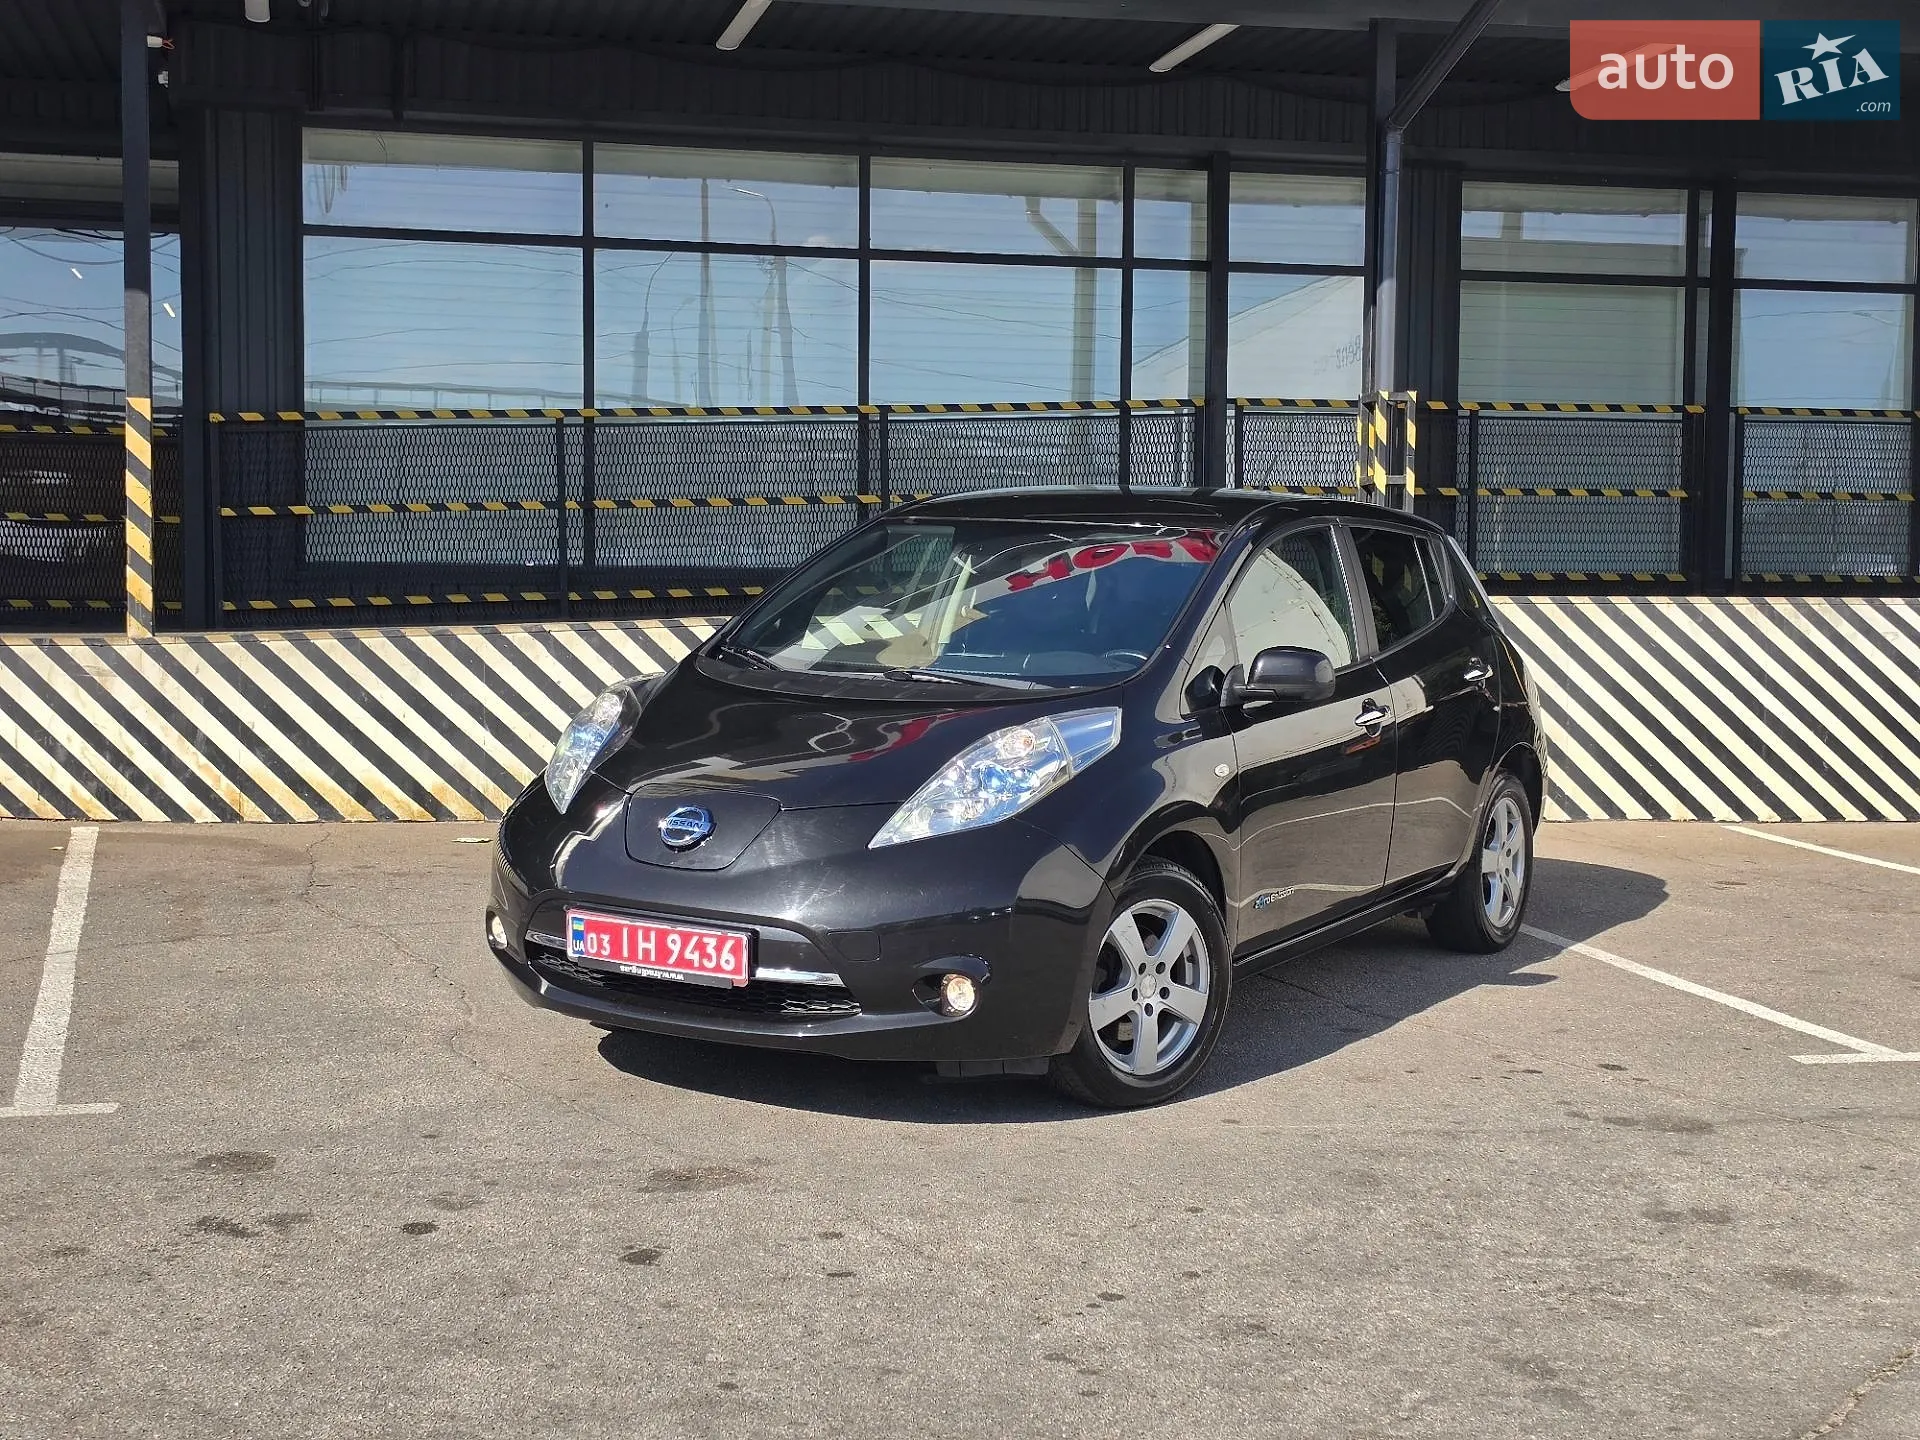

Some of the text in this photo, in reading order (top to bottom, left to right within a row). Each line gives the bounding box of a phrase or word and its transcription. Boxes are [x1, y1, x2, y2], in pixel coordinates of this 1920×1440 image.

[573, 939, 585, 952] UA
[587, 927, 736, 971] 03 IH 9436
